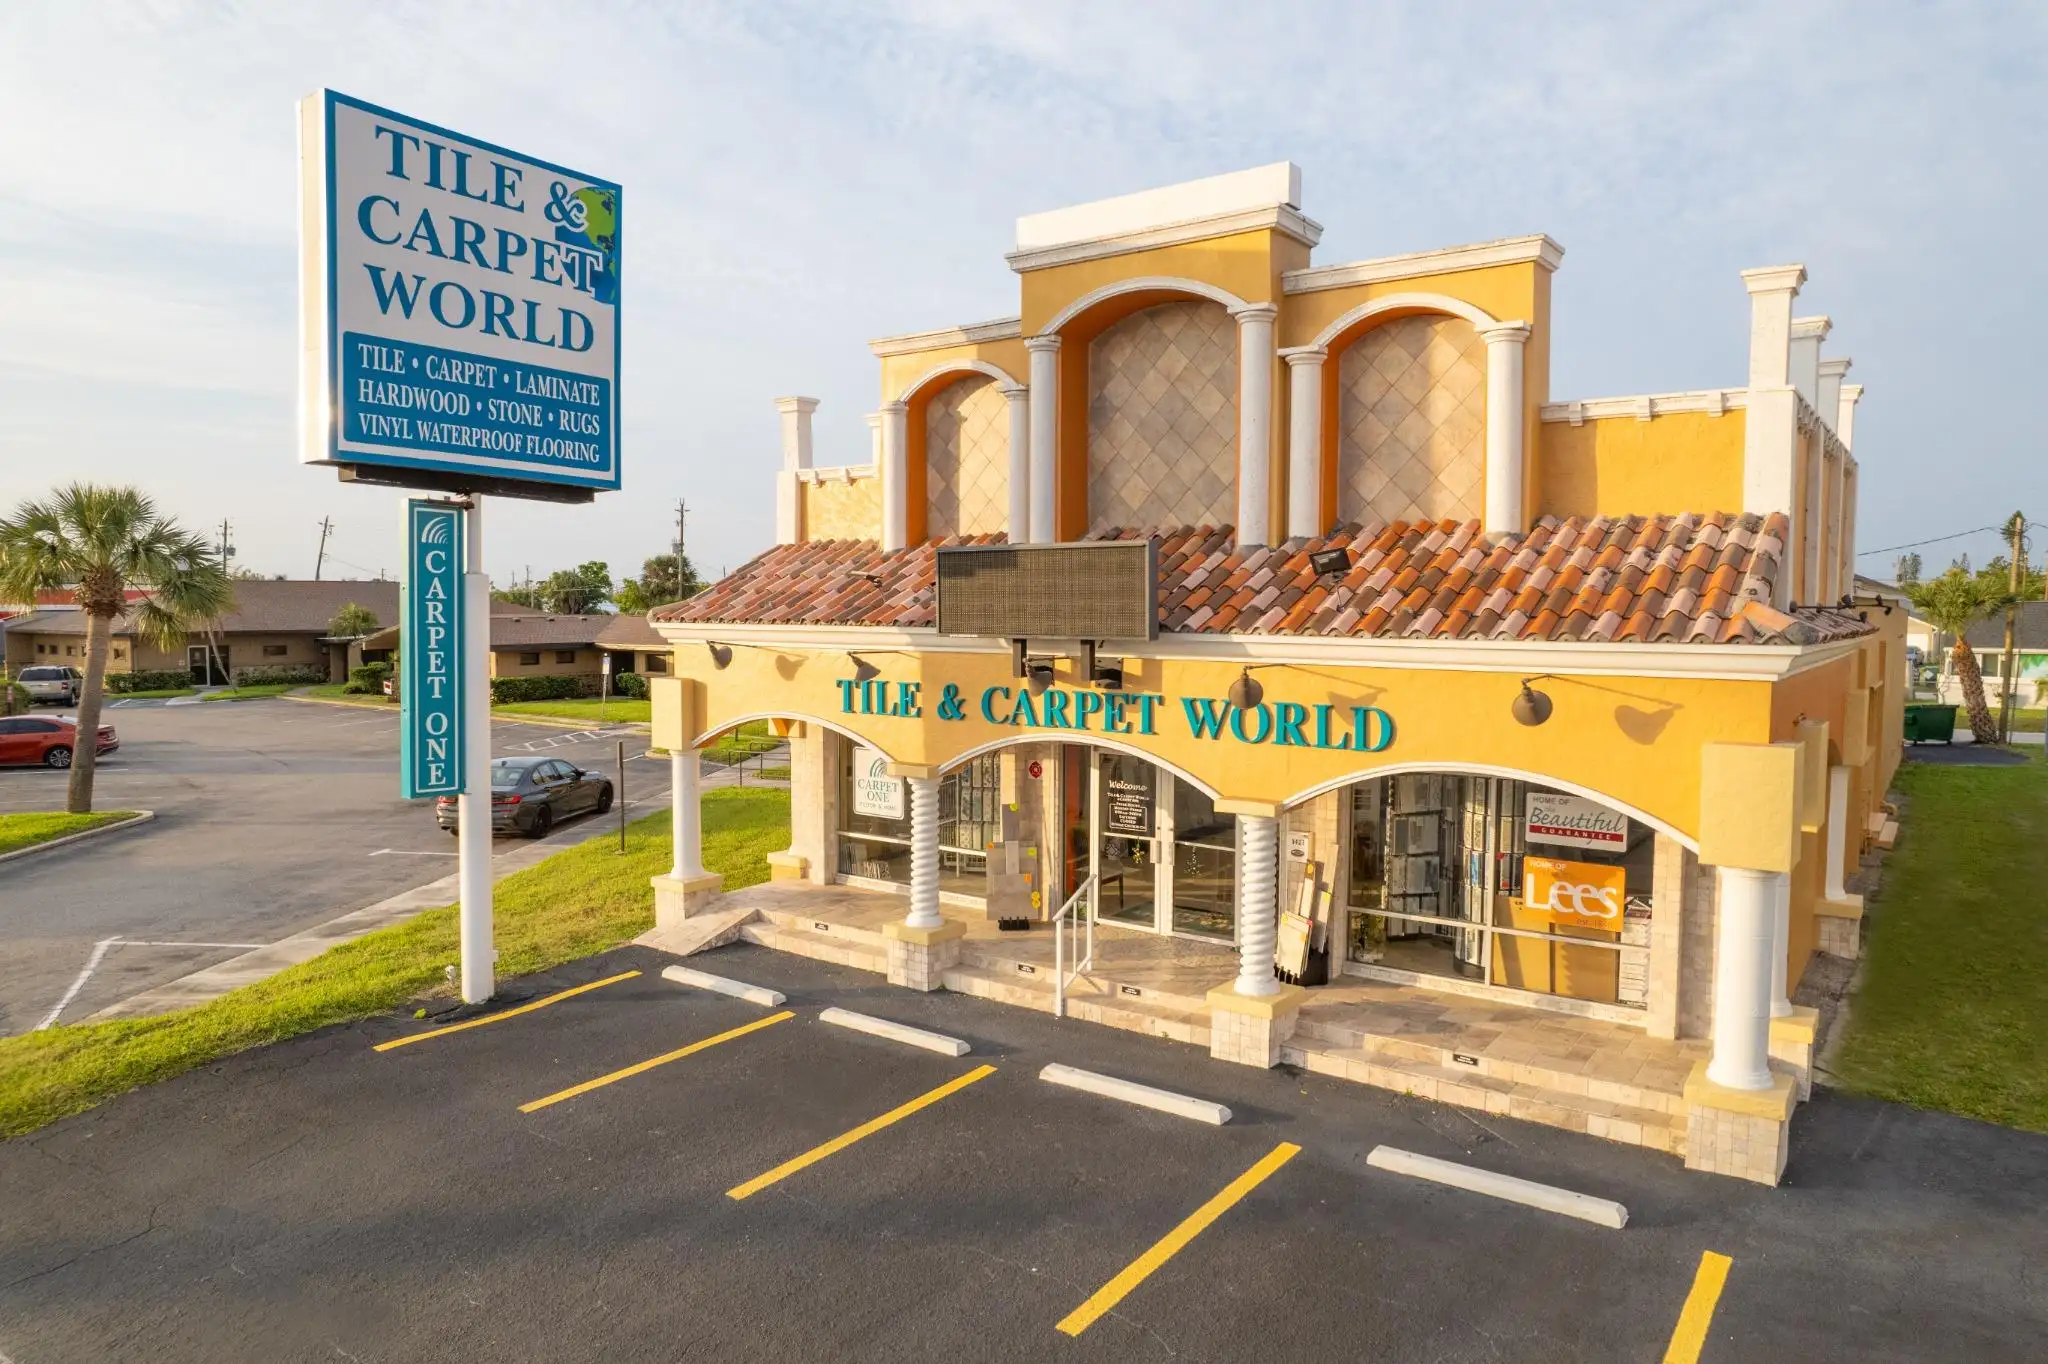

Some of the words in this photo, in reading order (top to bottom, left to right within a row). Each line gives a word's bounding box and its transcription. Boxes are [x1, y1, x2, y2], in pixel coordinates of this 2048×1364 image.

[375, 125, 525, 213] TILE
[543, 181, 588, 232] &
[357, 195, 604, 293] CARPET
[363, 264, 594, 352] WORLD
[358, 343, 406, 374] TILE
[426, 355, 498, 389] CARPET
[516, 371, 600, 406] LAMINATE
[358, 379, 470, 416] HARDWOOD
[488, 399, 543, 427] STONE
[559, 410, 600, 436] RUGS
[358, 412, 413, 440] VINYL
[417, 420, 522, 454] WATERPROOF
[526, 436, 600, 463] FLOORING
[425, 551, 447, 699] CARPET
[836, 679, 922, 718] TILE
[937, 683, 966, 721] &
[981, 685, 1164, 735] CARPET
[1180, 697, 1396, 753] WORLD
[425, 712, 448, 786] ONE
[858, 778, 899, 793] CARPET
[867, 790, 889, 803] ONE
[1109, 780, 1147, 791] Welcome
[1533, 796, 1556, 804] HOME
[1530, 807, 1624, 845] Beautiful
[1541, 827, 1611, 840] GUARANTEE
[1526, 873, 1618, 920] Lees
